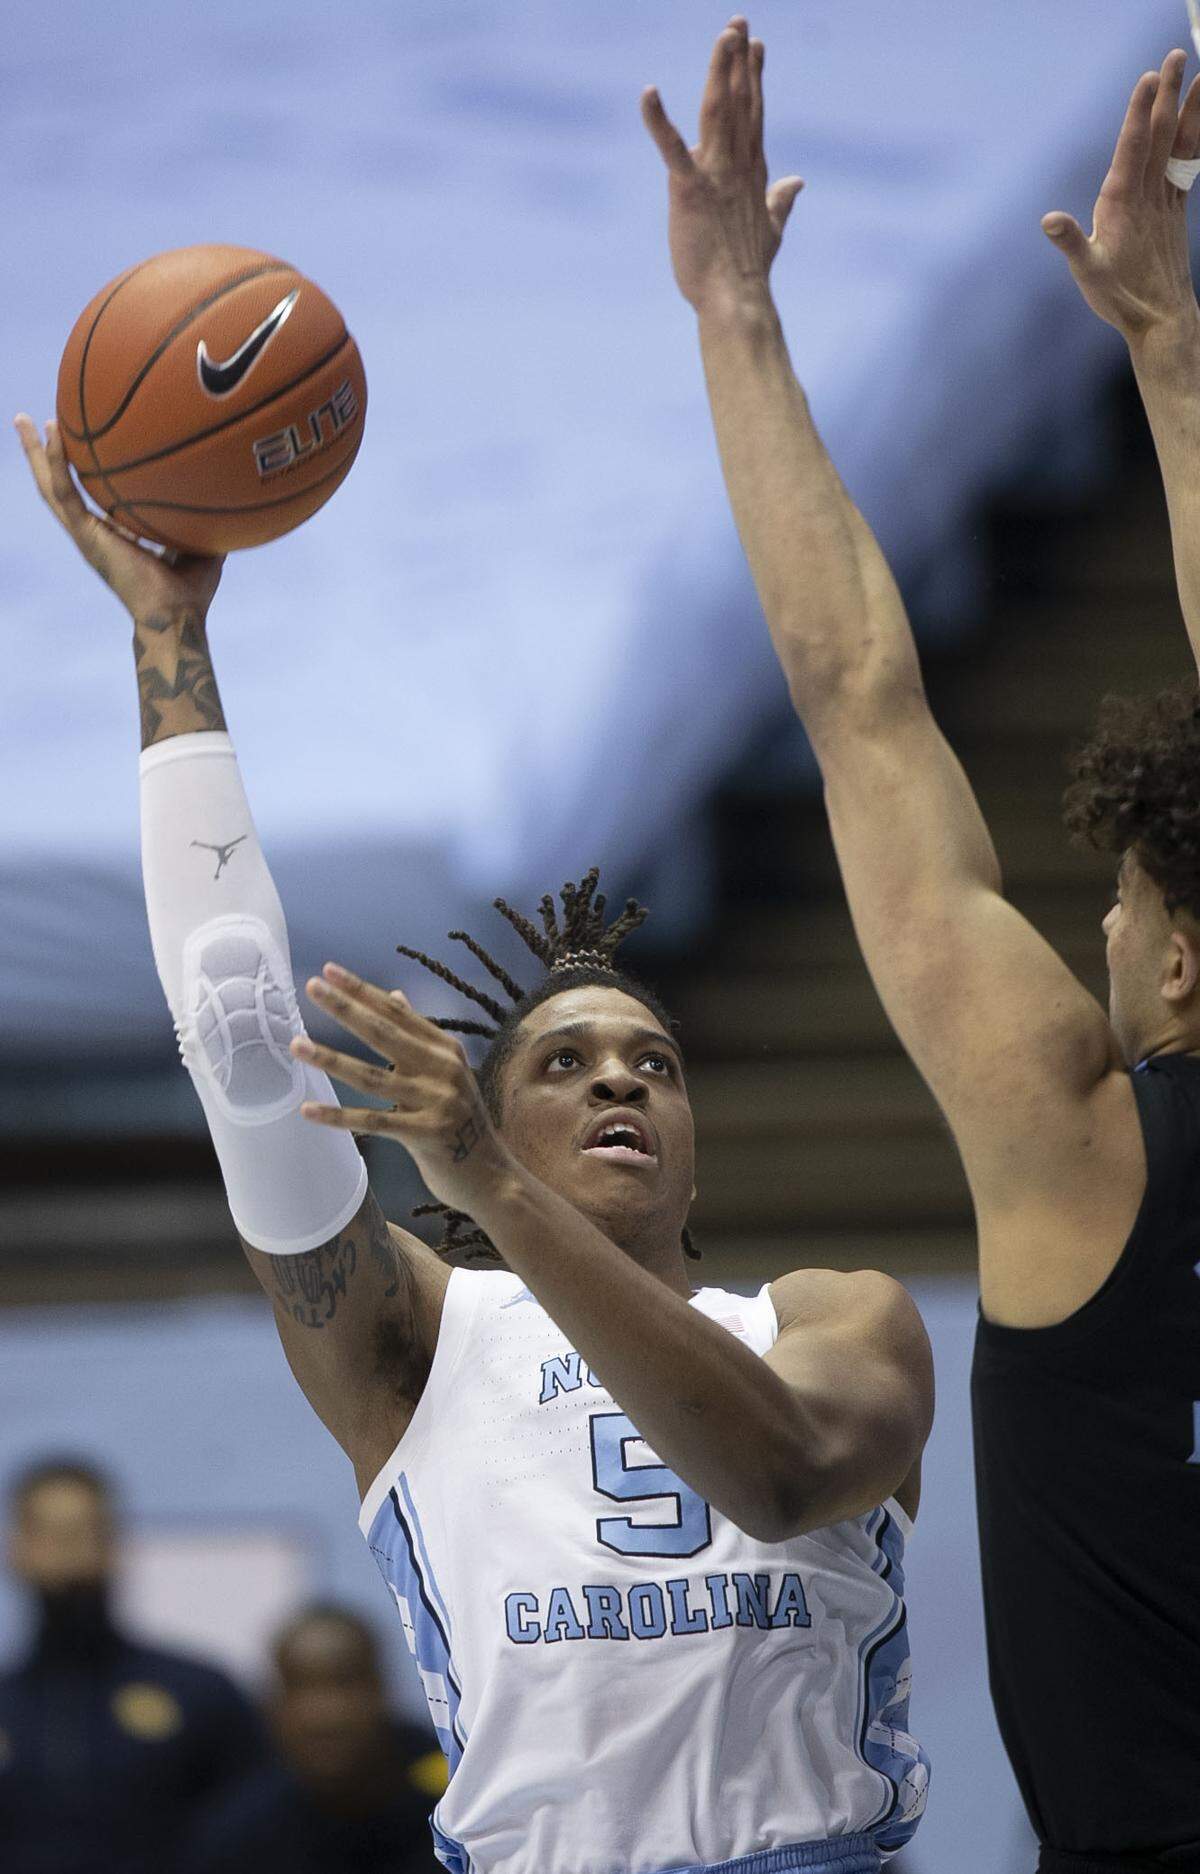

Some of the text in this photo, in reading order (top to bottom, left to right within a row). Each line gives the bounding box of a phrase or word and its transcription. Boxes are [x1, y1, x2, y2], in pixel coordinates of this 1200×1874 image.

[252, 378, 359, 477] ELITE
[589, 1411, 713, 1559] 5
[504, 1572, 812, 1645] CAROLINA
